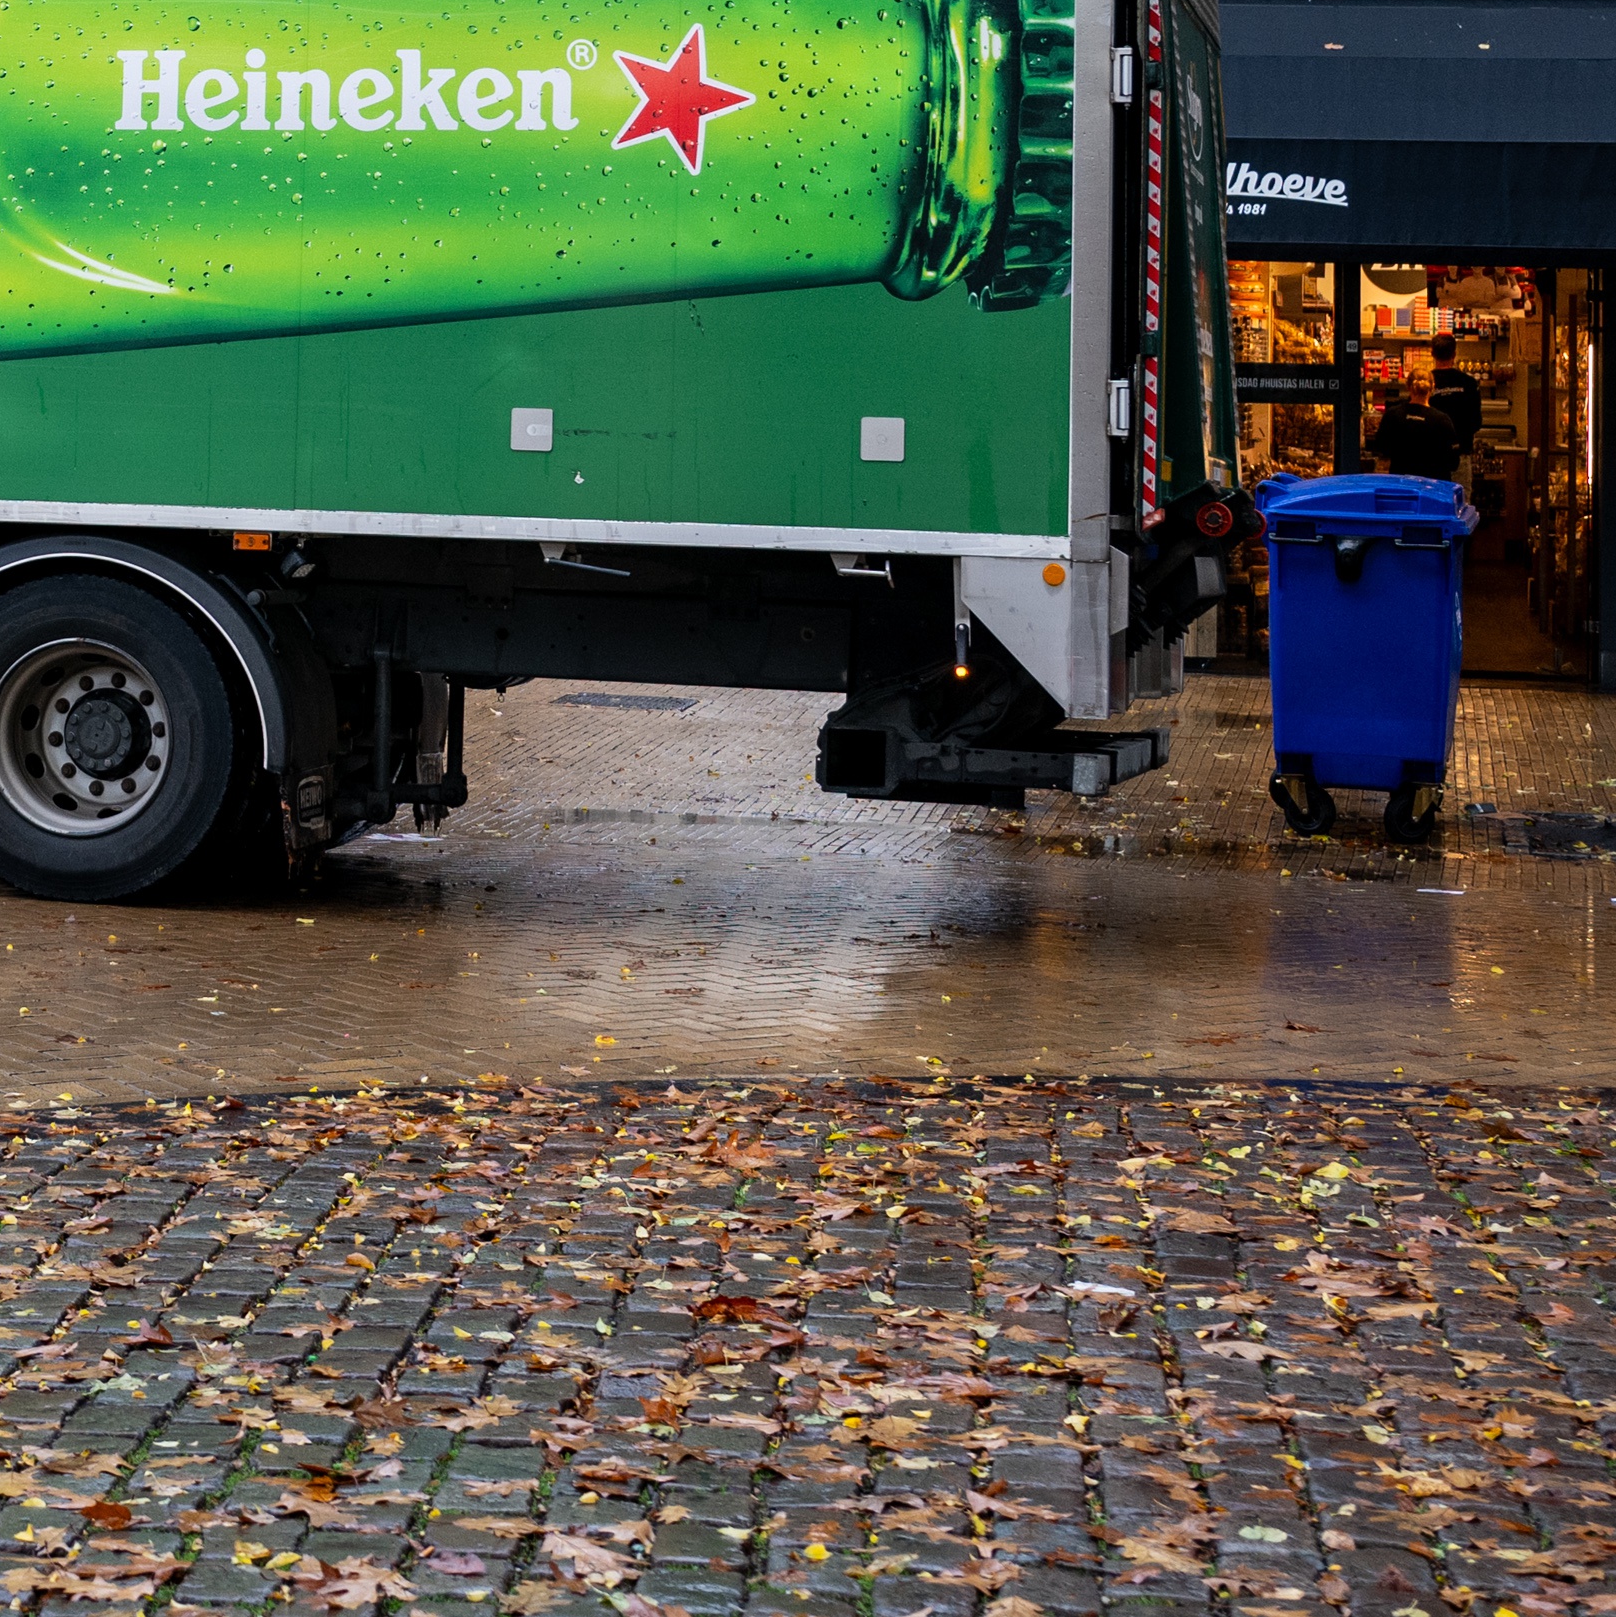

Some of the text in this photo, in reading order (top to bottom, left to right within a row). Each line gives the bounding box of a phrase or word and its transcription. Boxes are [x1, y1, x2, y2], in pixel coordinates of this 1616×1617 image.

[115, 48, 579, 131] Heineken
[1237, 204, 1266, 215] 1981
[1298, 378, 1324, 389] HALEN
